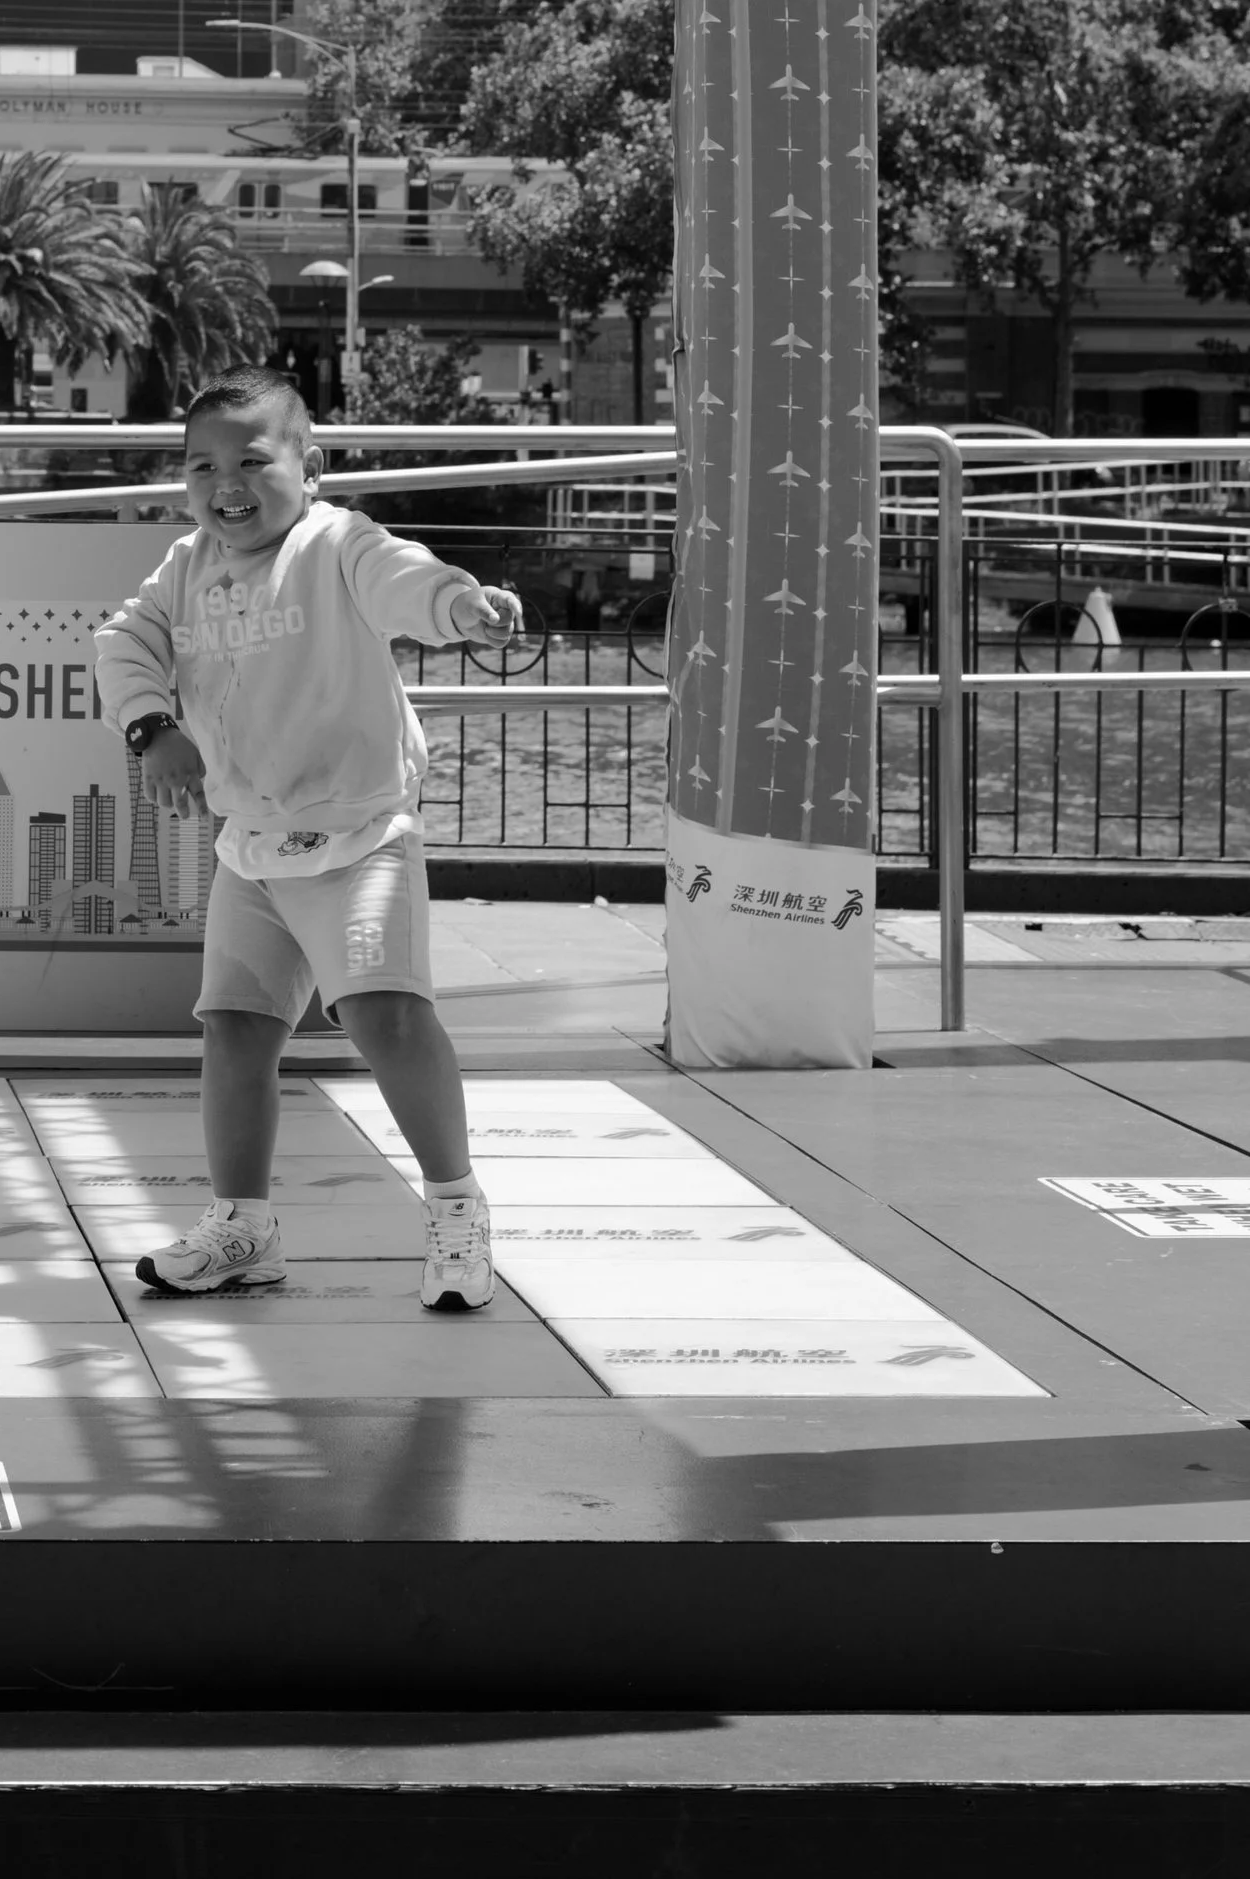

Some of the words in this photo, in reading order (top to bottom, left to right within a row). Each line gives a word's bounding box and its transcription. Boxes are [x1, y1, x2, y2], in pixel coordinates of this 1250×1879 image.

[86, 100, 143, 115] HOUSE
[171, 621, 220, 654] SAN
[733, 884, 827, 913] 深圳航空
[730, 903, 781, 920] Shenzhen
[784, 912, 825, 925] Airlines
